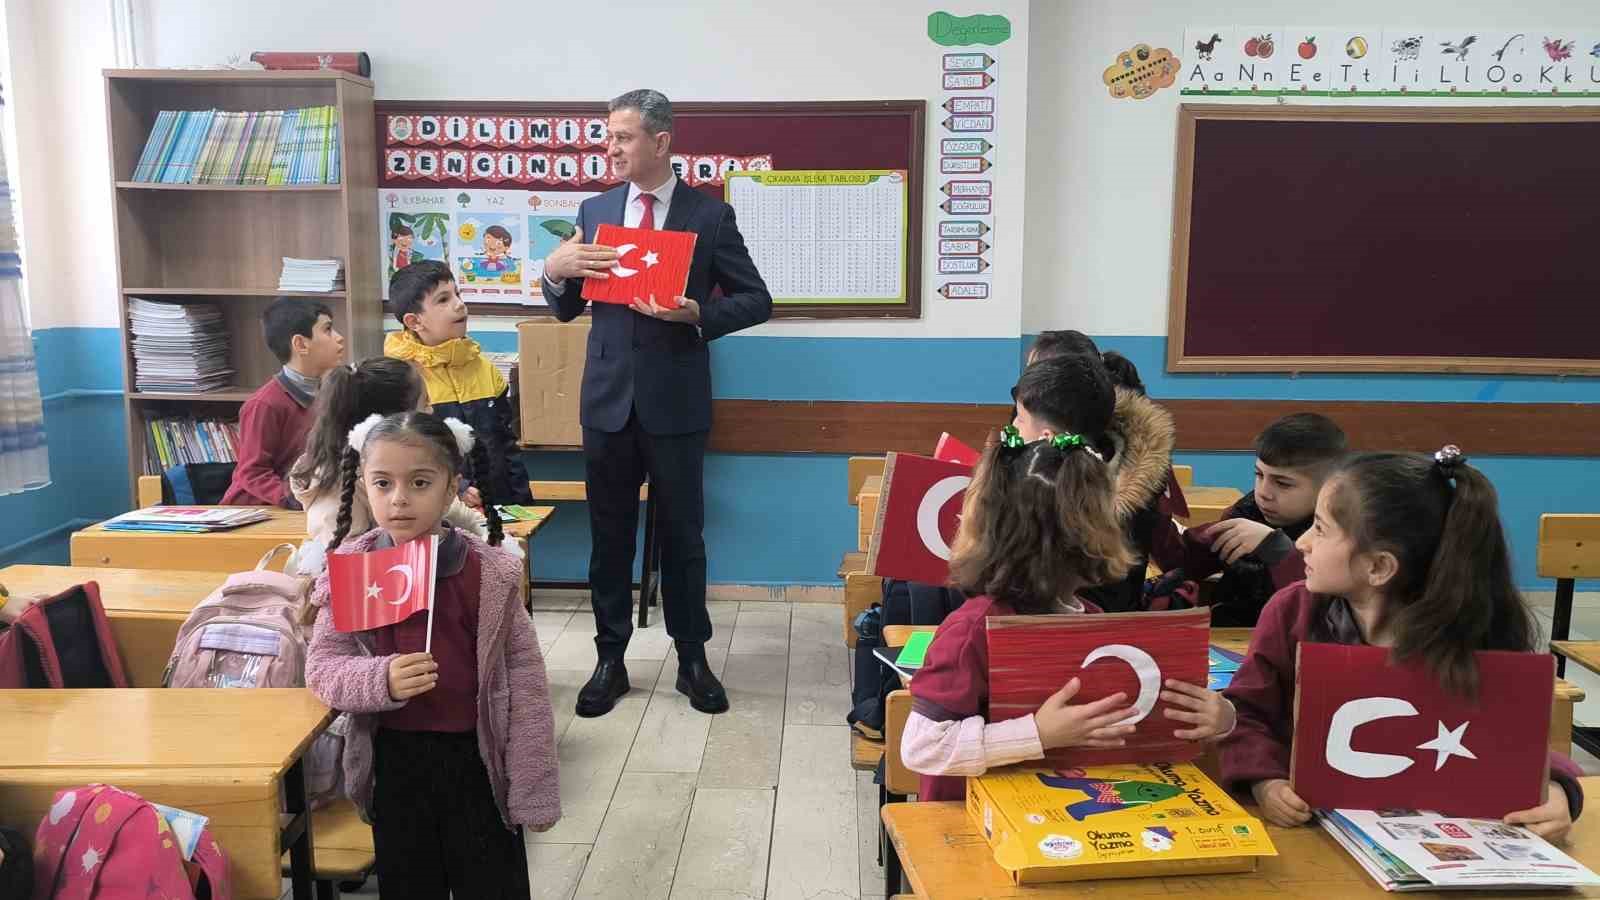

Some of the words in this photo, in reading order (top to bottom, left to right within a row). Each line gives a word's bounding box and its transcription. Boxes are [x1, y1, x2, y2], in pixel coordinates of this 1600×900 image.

[487, 196, 504, 206] YAZ
[950, 285, 985, 296] ADALET
[1086, 829, 1132, 841] Okuma
[1088, 840, 1135, 852] Yazma
